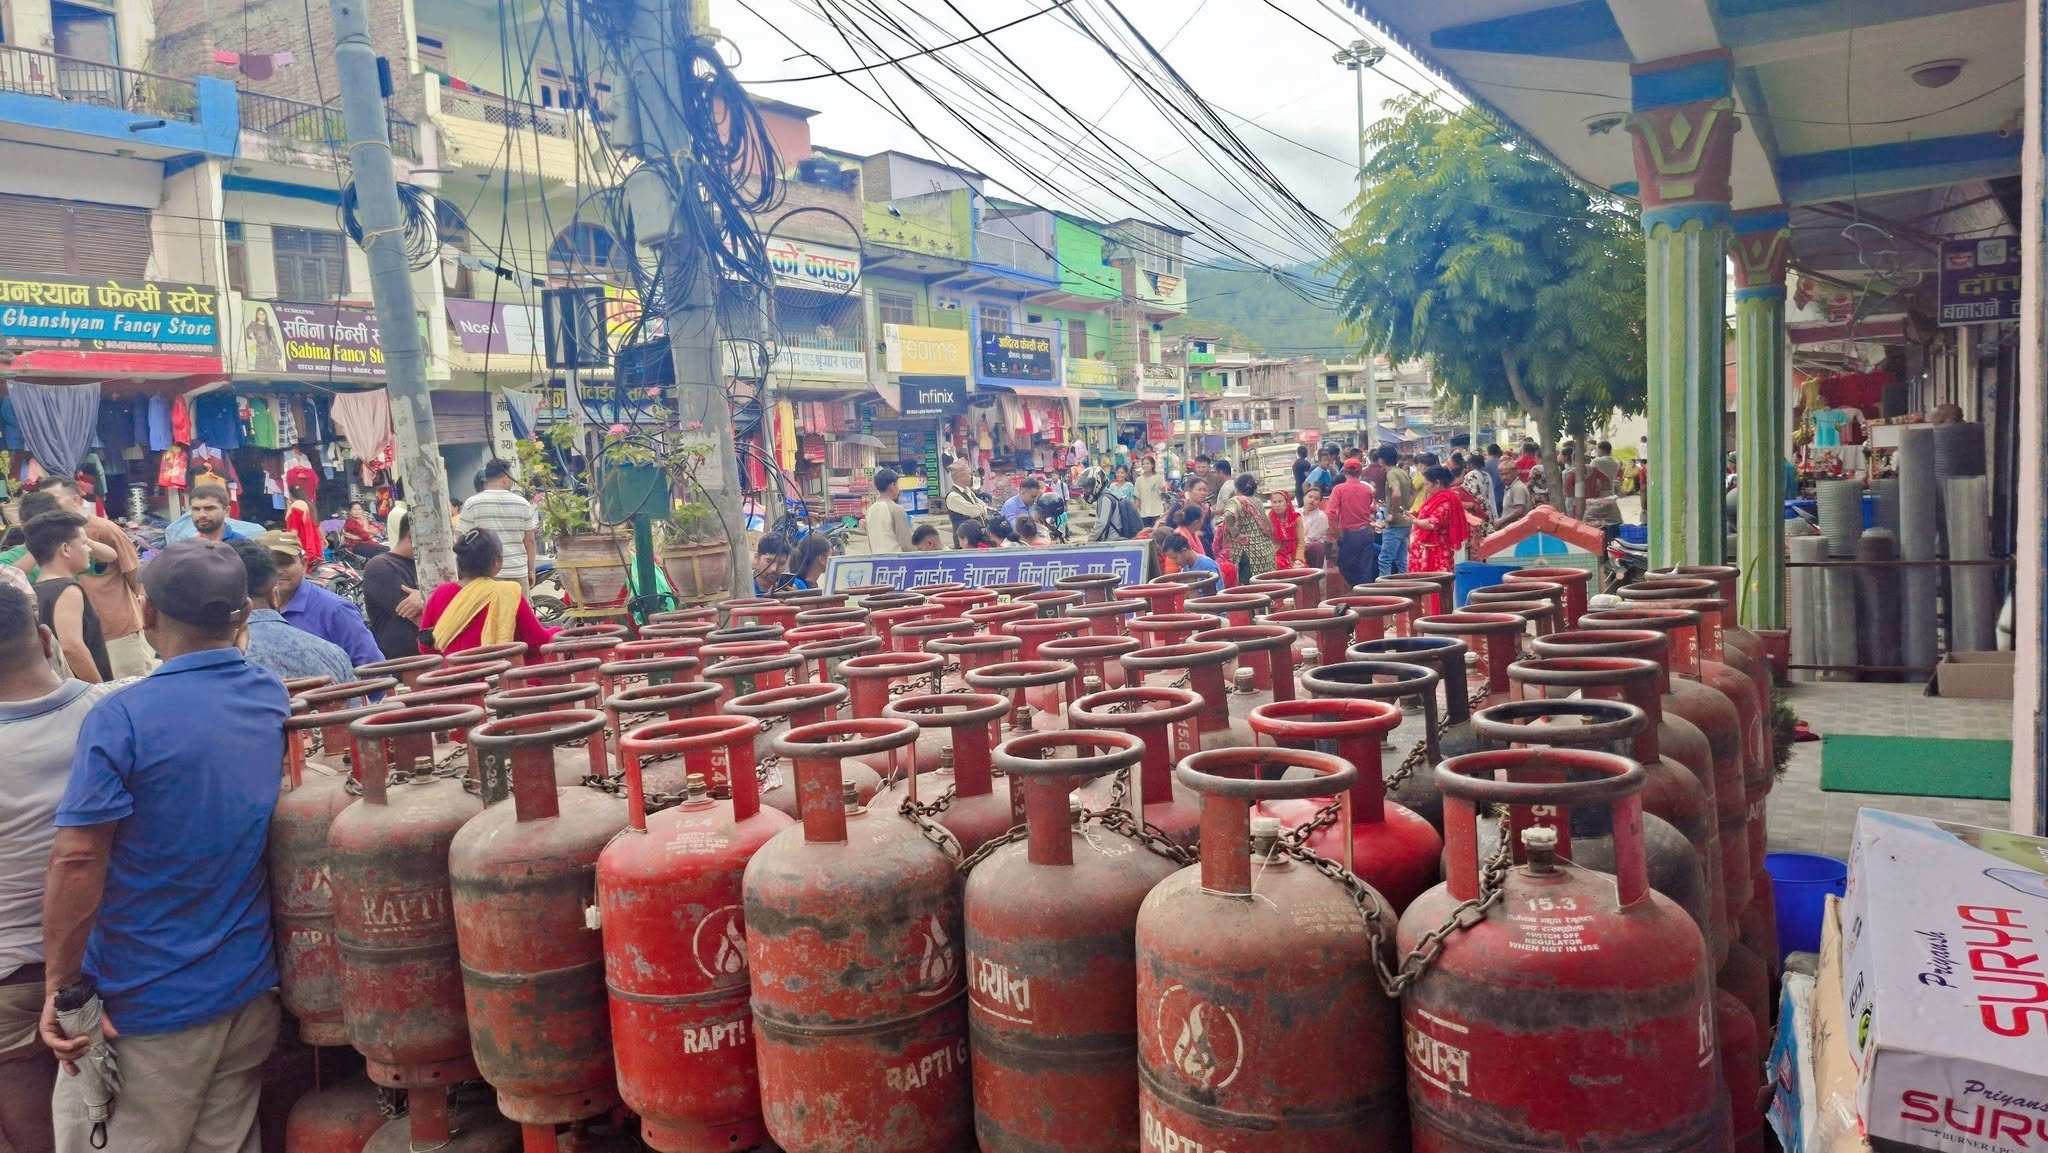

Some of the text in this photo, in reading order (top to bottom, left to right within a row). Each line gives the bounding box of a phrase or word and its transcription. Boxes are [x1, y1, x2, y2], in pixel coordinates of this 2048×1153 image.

[805, 254, 856, 282] कपडा
[96, 280, 161, 311] फेन्सी
[167, 286, 214, 315] स्टोर
[2, 308, 211, 337] Ghanshyam Fancy Store
[282, 315, 325, 340] सबिना
[460, 320, 499, 336] Ncell
[334, 345, 366, 366] Fancy
[919, 389, 954, 404] Infinix
[711, 746, 726, 783] 15.4
[1526, 897, 1577, 912] 15.3
[1509, 941, 1539, 952] WHEN
[1580, 943, 1600, 951] USE
[1524, 938, 1583, 946] REGULATOR
[1563, 931, 1580, 939] OFF
[1914, 927, 1962, 990] Priyansh
[1957, 904, 2048, 1037] SURYA
[885, 1045, 953, 1092] RAPTI
[1901, 1089, 2048, 1148] SUR
[1942, 1133, 1989, 1151] BURNER
